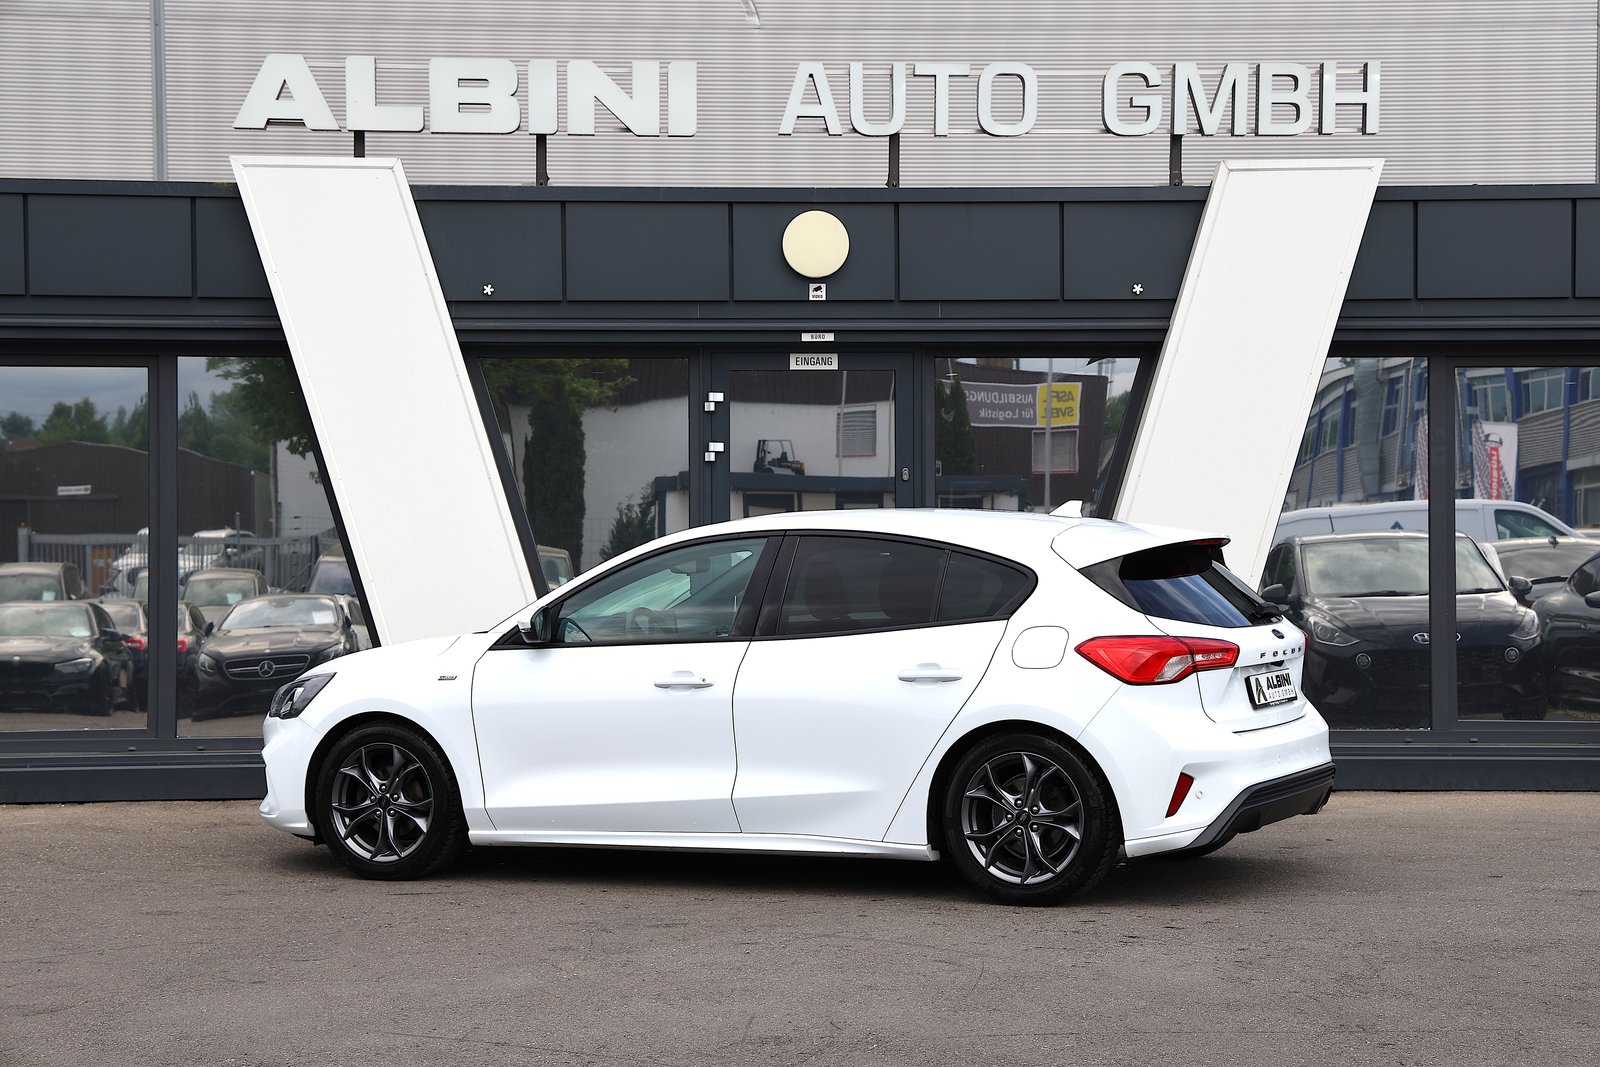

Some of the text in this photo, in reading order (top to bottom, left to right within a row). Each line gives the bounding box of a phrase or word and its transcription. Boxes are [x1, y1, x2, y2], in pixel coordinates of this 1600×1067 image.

[233, 53, 1381, 137] ALBINI AUTO GMBH
[795, 356, 833, 366] EINGANG
[1260, 646, 1302, 659] FOCUS
[1266, 672, 1292, 690] ALBINI
